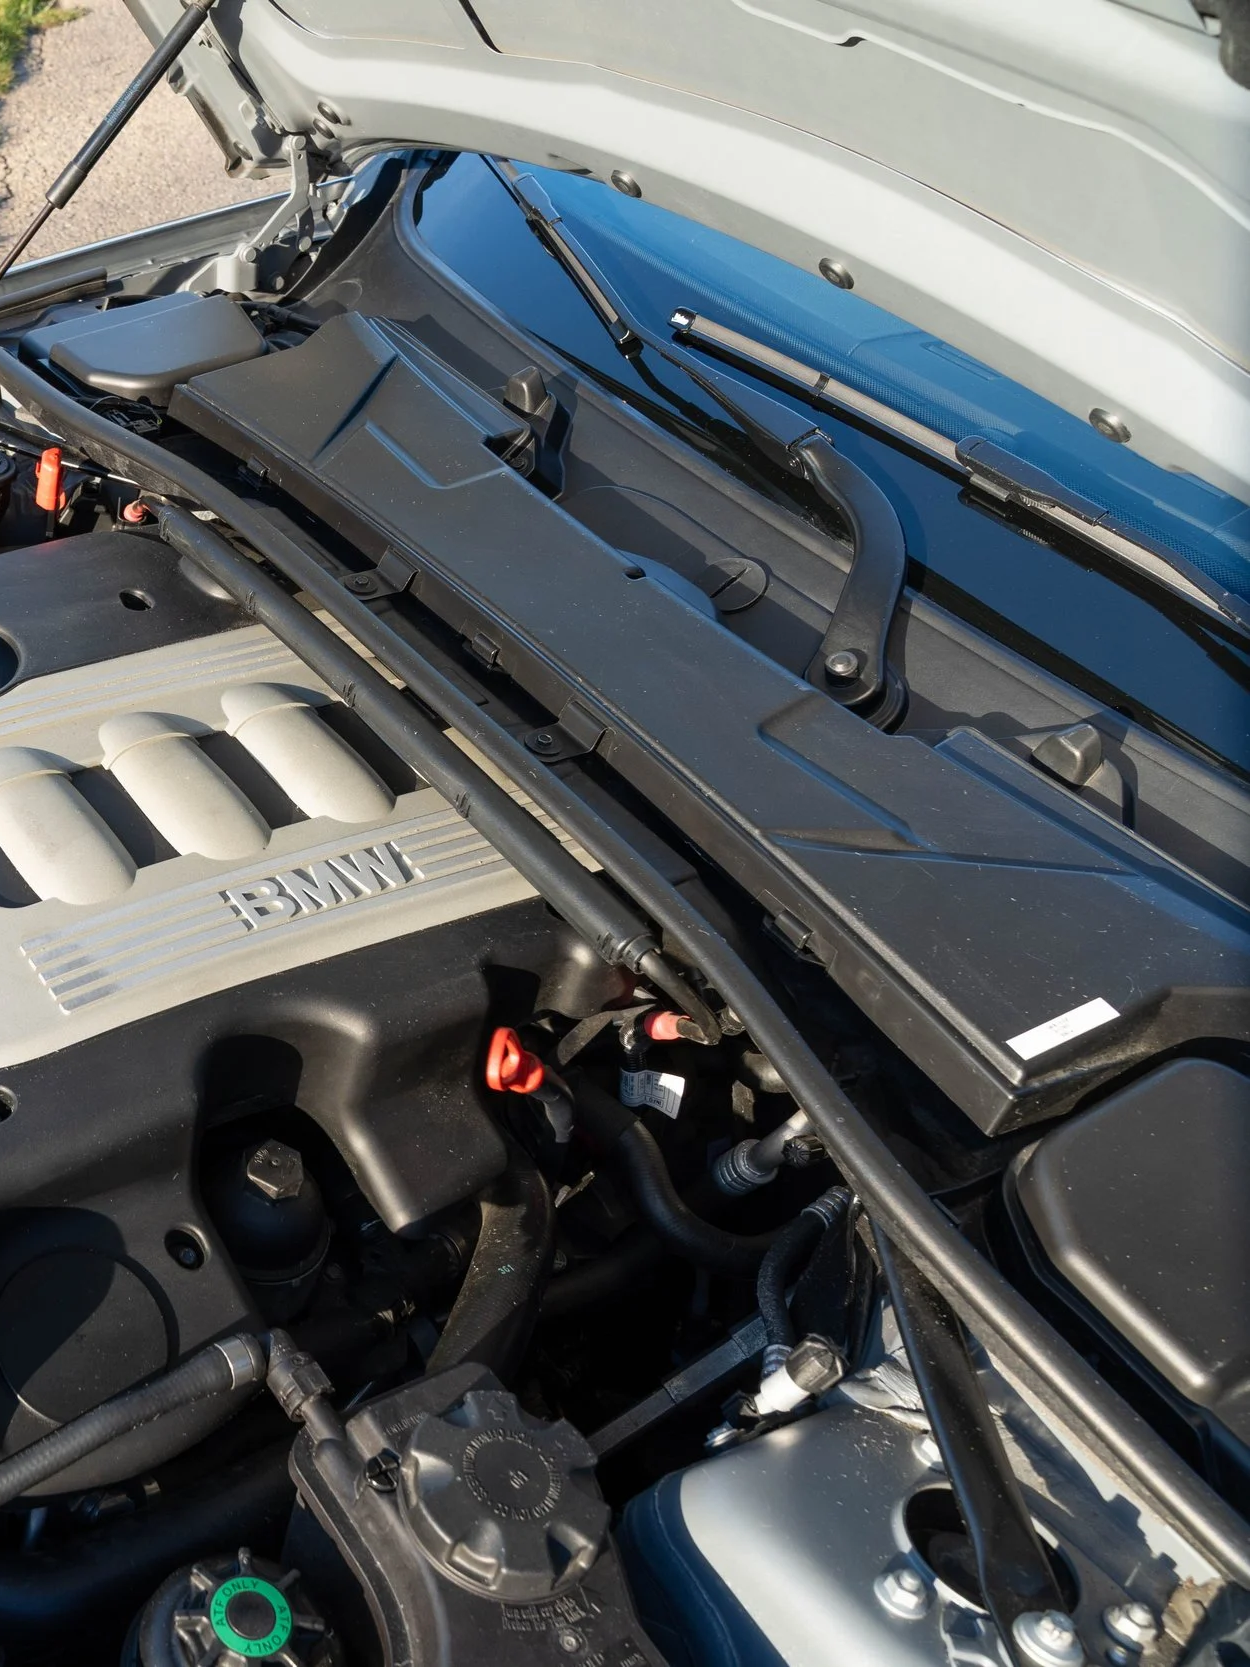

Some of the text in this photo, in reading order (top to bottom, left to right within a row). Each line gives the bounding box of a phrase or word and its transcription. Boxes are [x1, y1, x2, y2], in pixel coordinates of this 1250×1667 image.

[225, 841, 417, 930] BMW
[214, 1578, 260, 1627] ATF ONLY
[244, 1604, 291, 1653] ATF ONLY
